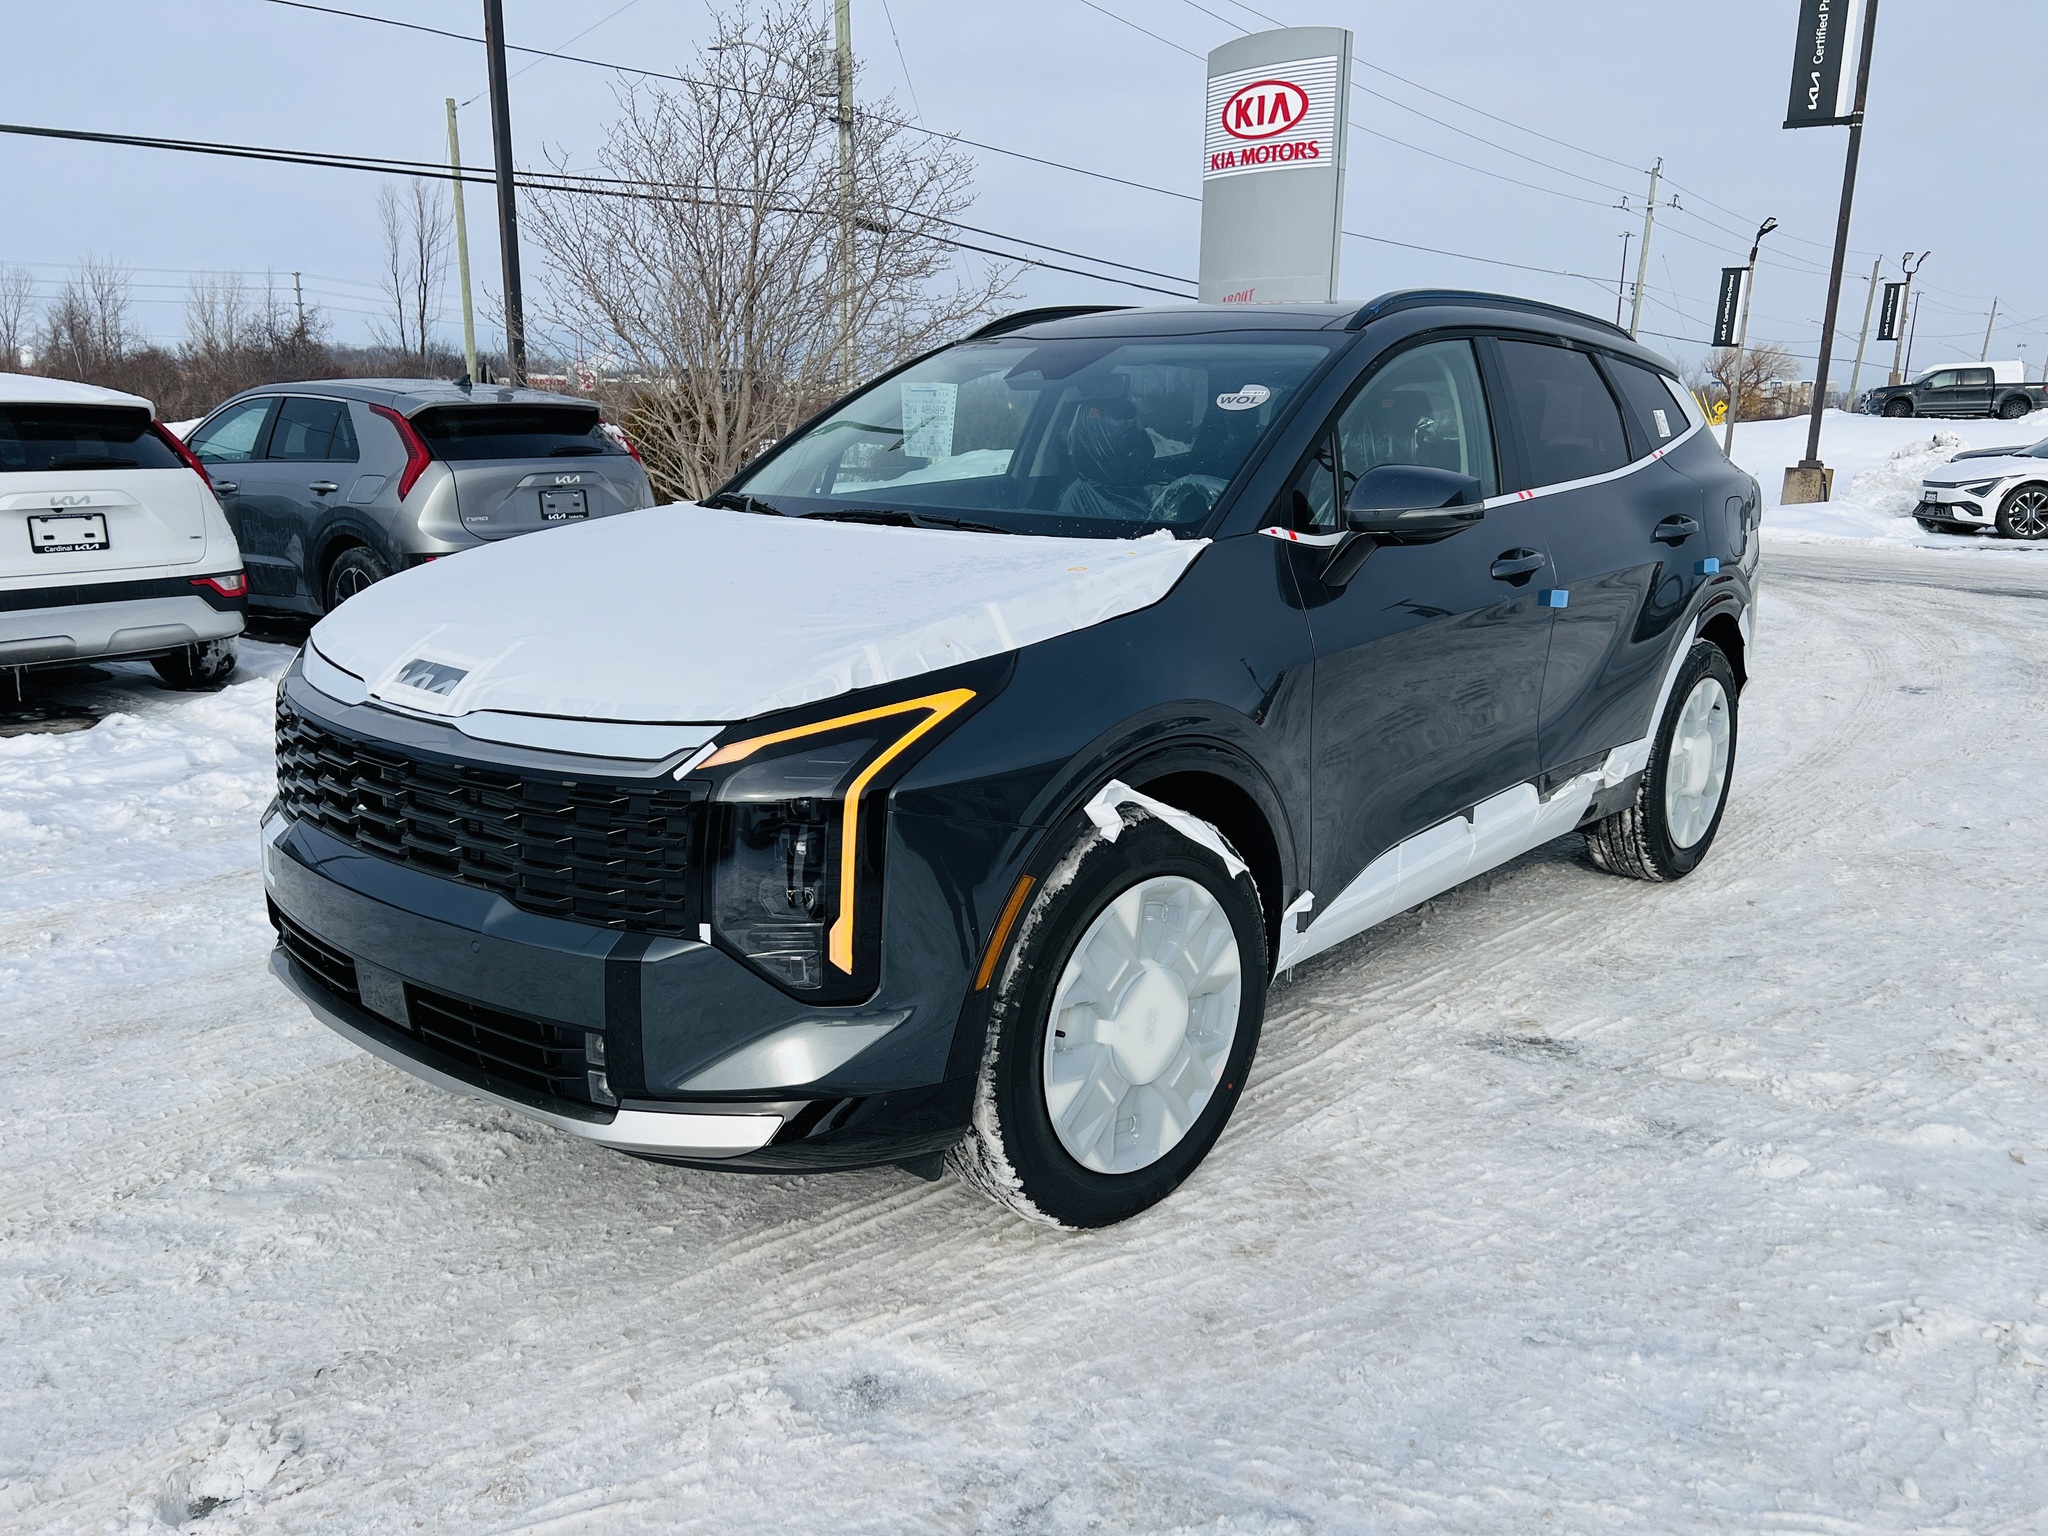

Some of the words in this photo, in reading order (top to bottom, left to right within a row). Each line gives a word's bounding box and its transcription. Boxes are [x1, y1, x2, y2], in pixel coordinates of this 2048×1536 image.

[1812, 13, 1829, 64] Certified
[1234, 92, 1291, 129] KIA
[1211, 151, 1236, 170] KIA
[1240, 140, 1320, 166] MOTORS
[1726, 274, 1735, 302] Pre-Owned
[1722, 301, 1731, 323] Certified
[1220, 396, 1260, 404] WOL
[44, 545, 73, 553] Cardinal
